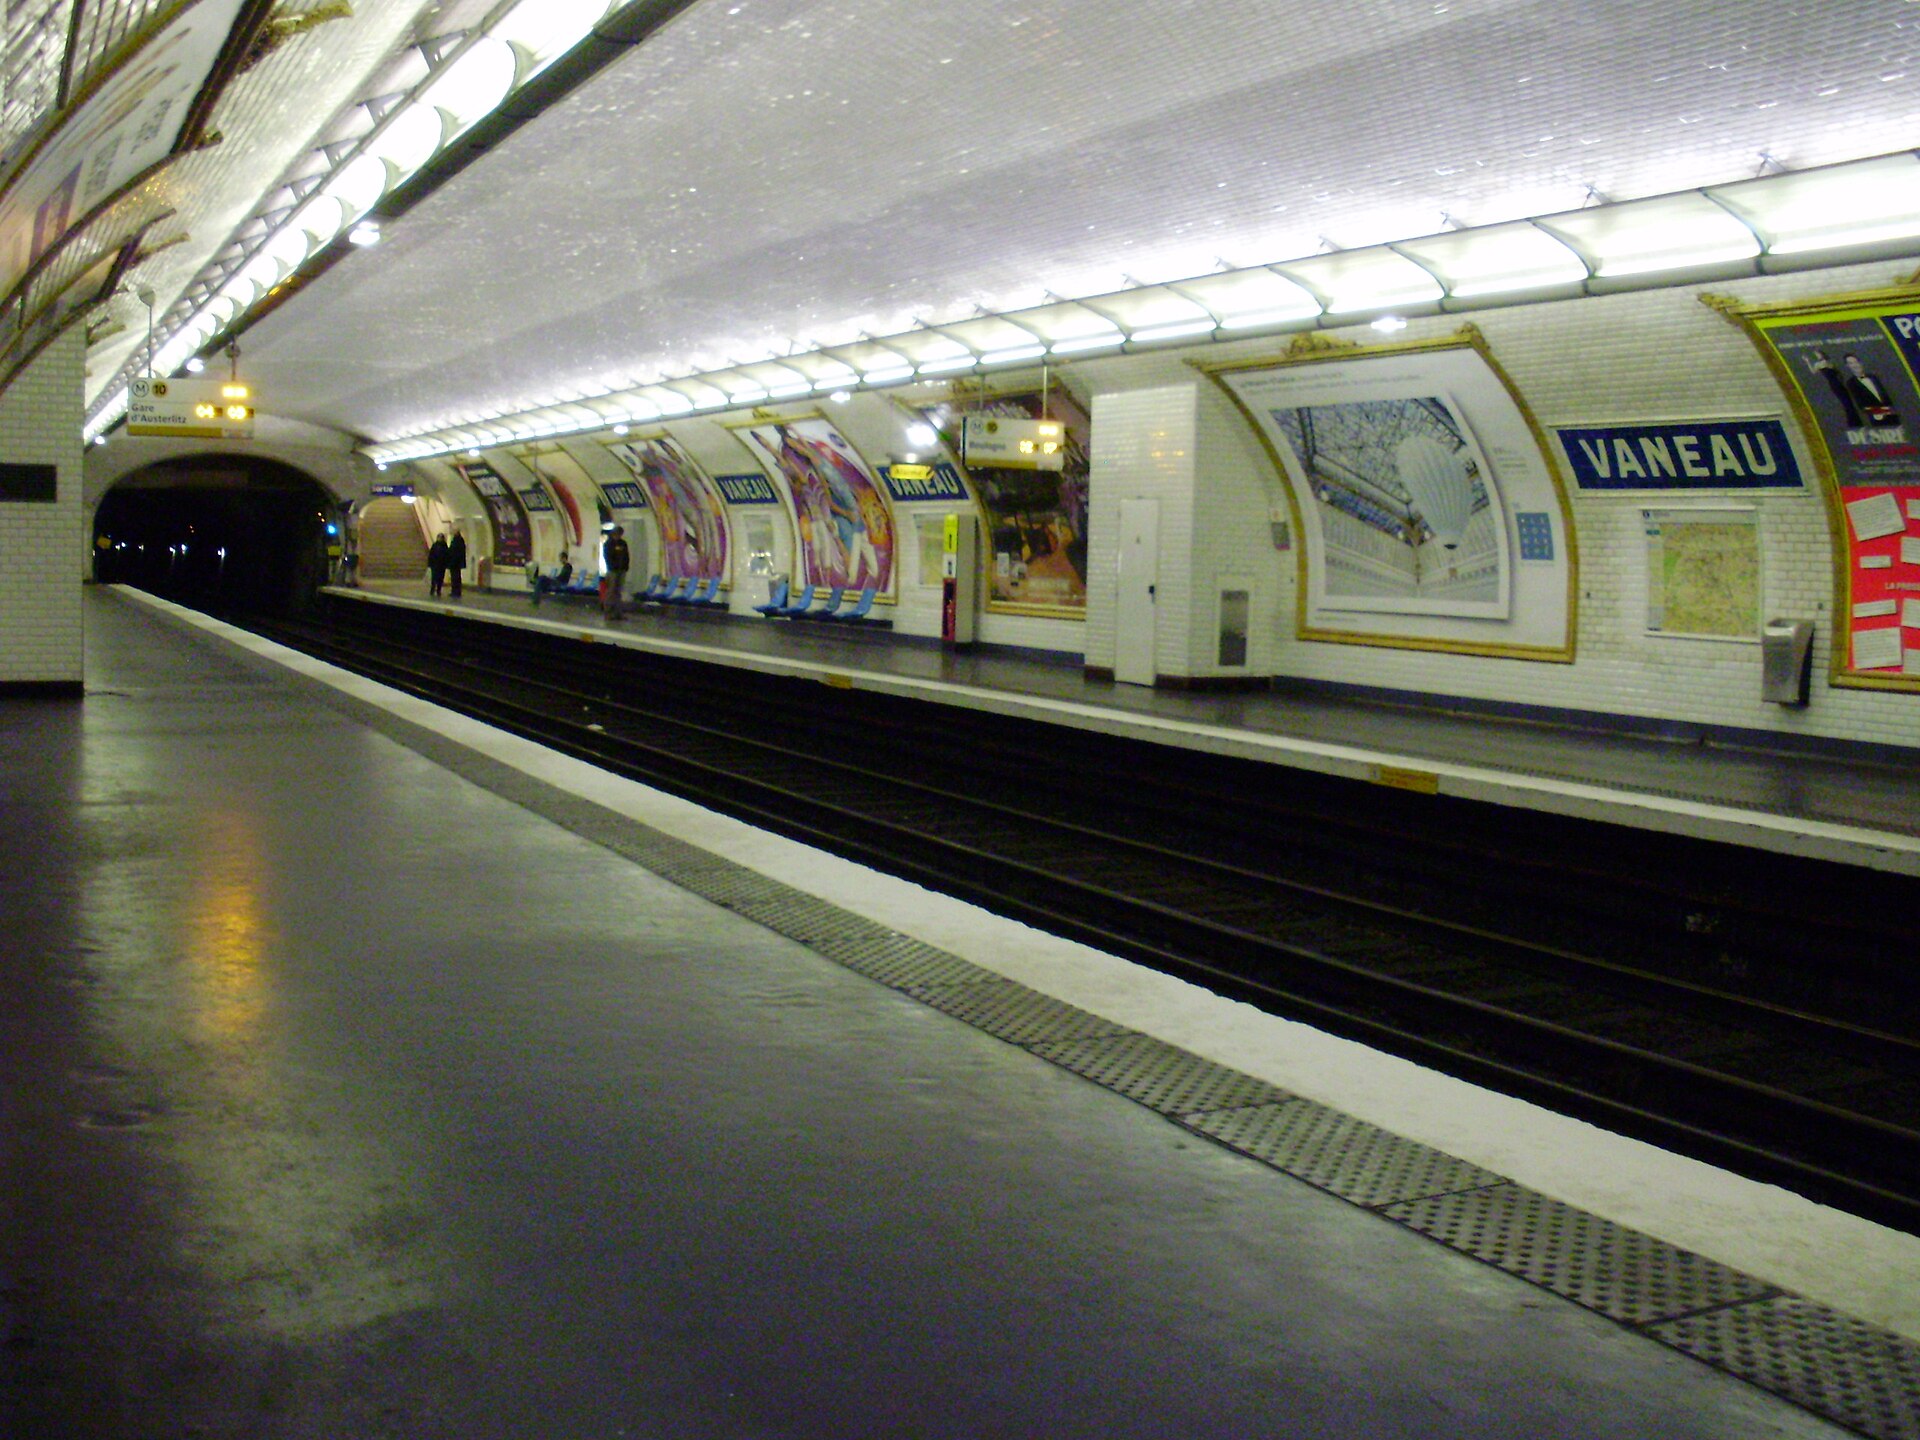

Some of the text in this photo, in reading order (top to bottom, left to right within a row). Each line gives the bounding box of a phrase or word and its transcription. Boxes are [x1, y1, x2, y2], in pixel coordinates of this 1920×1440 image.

[154, 384, 167, 395] 10
[131, 403, 154, 413] Gare
[131, 414, 187, 424] d'Austerlitz
[1578, 431, 1778, 479] VANEAU
[720, 479, 772, 500] VANEAU
